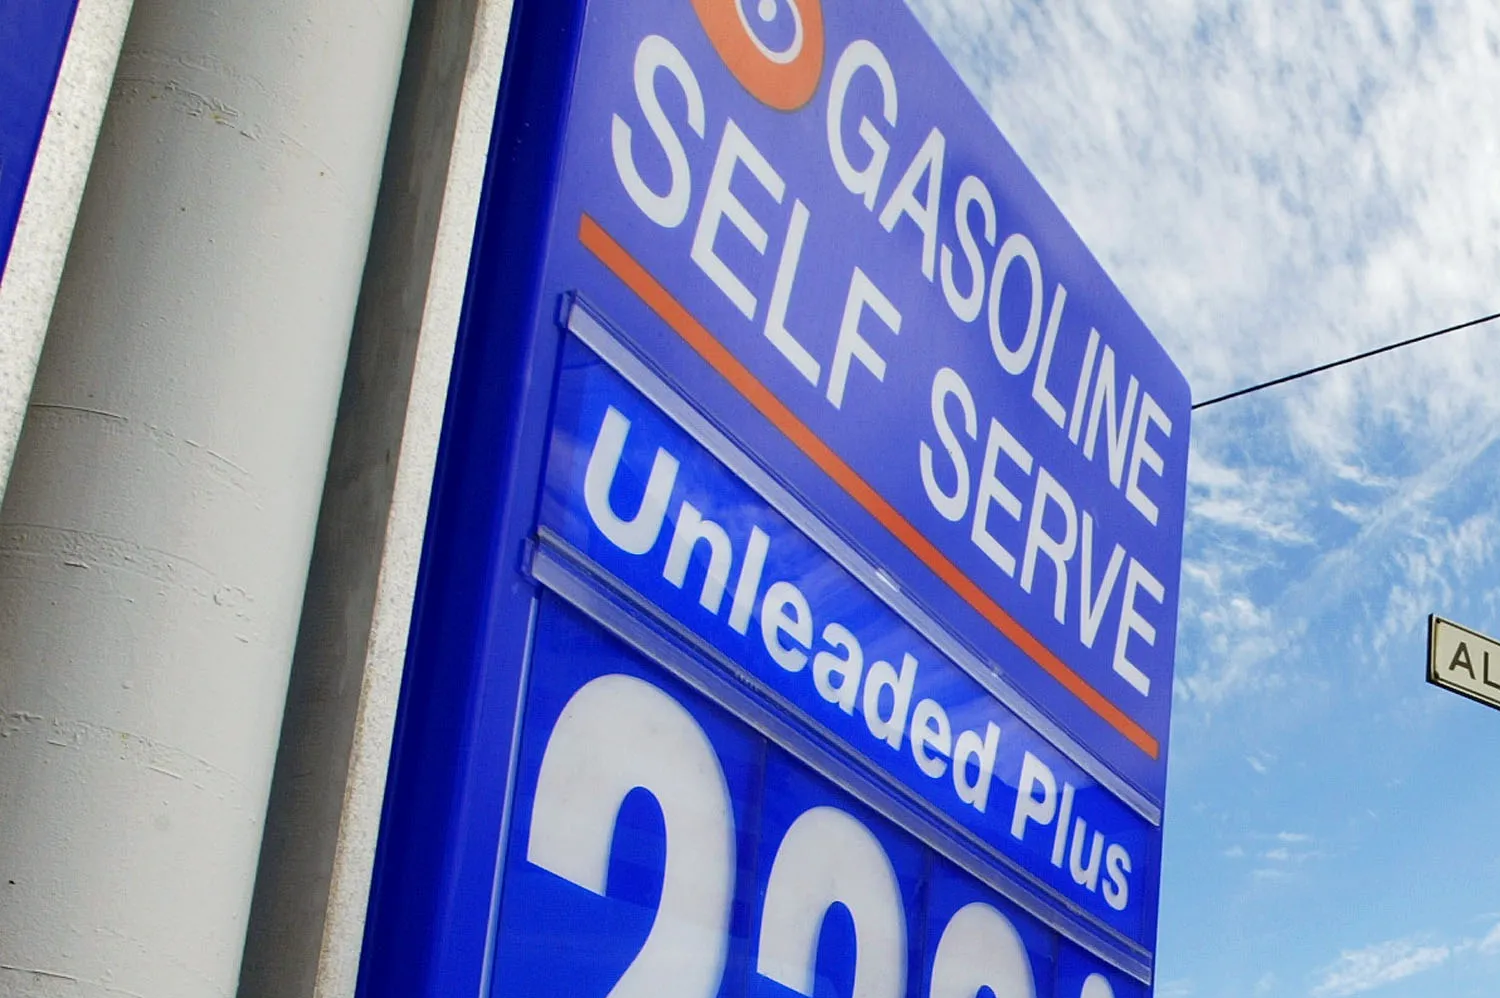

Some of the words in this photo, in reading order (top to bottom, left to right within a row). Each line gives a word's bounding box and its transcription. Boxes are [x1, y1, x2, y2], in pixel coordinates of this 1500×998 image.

[611, 34, 902, 410] SELF
[919, 367, 1165, 697] SERVE
[826, 39, 1172, 525] GASOLINE
[583, 404, 1000, 812] Unleaded
[1010, 760, 1132, 911] Plus
